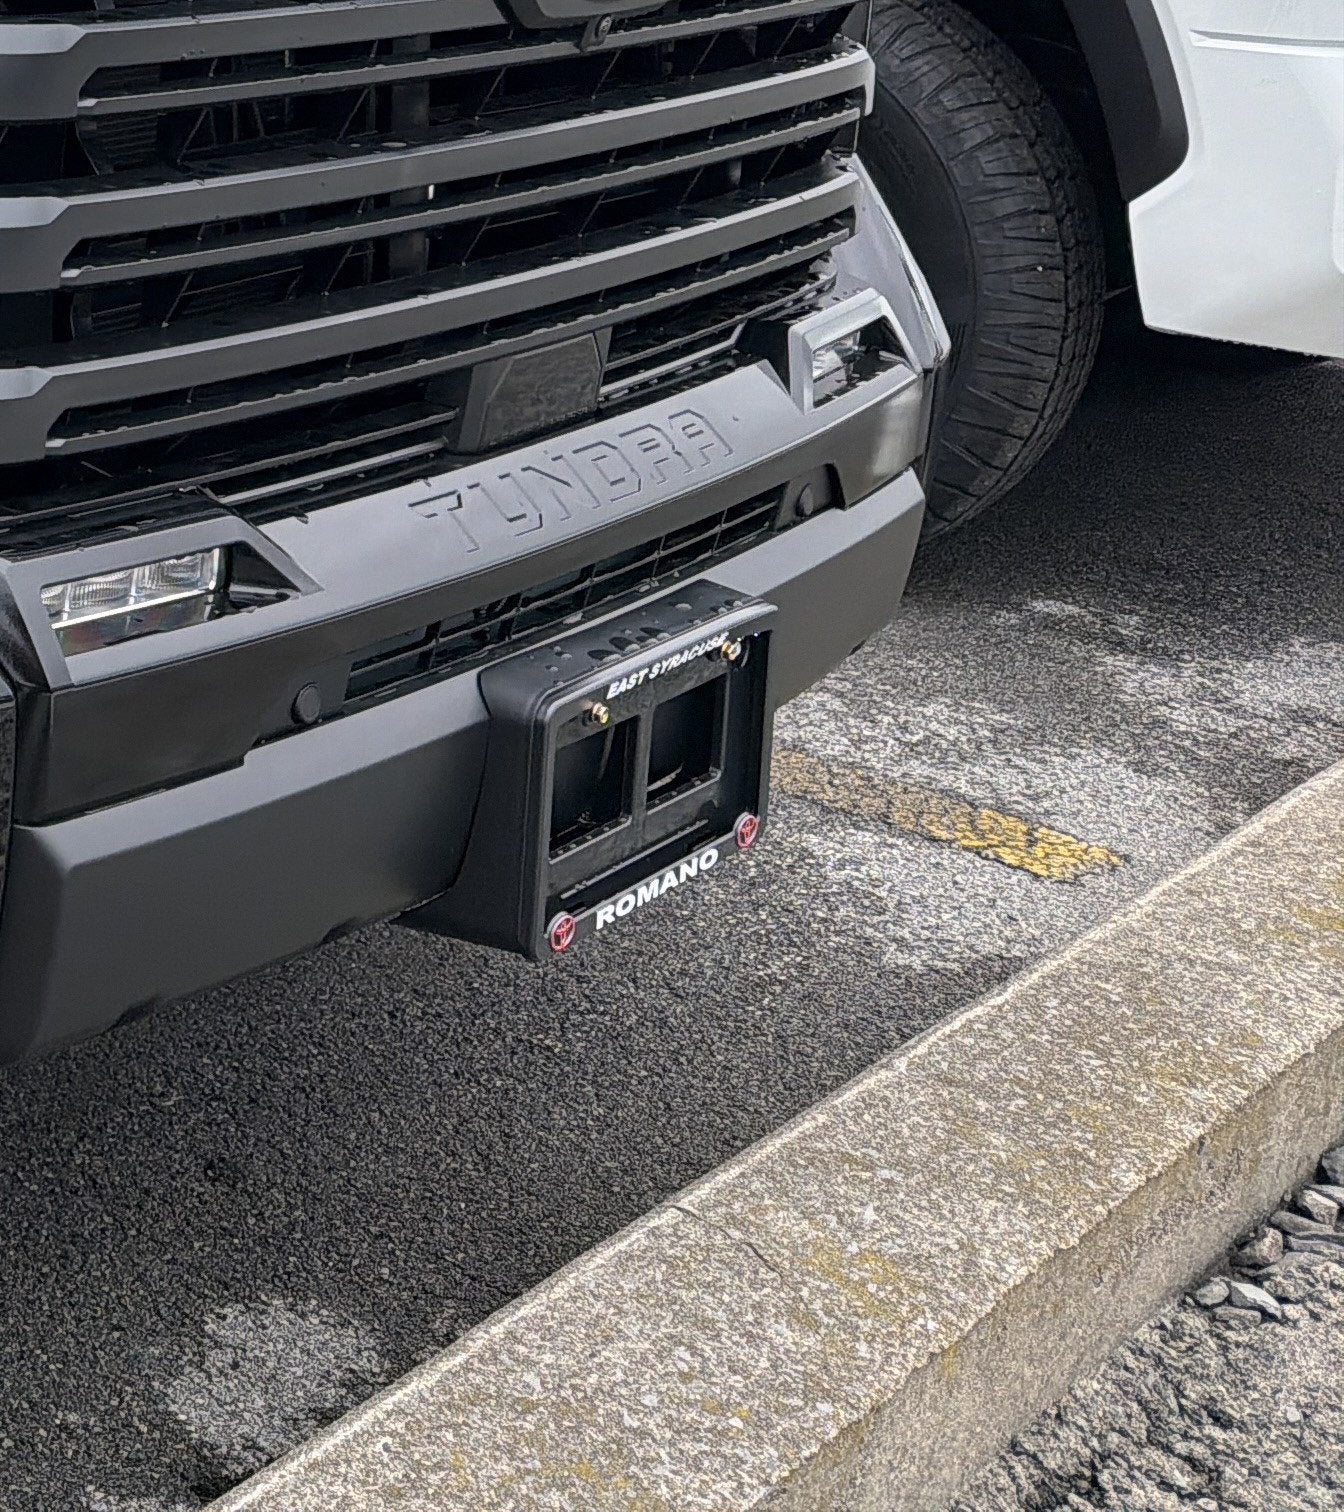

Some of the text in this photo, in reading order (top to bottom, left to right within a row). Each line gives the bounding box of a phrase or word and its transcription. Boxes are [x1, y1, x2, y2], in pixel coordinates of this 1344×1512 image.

[406, 408, 736, 554] TUNDRA
[605, 631, 730, 700] EAST SYRACUSE
[595, 846, 720, 931] ROMANO
